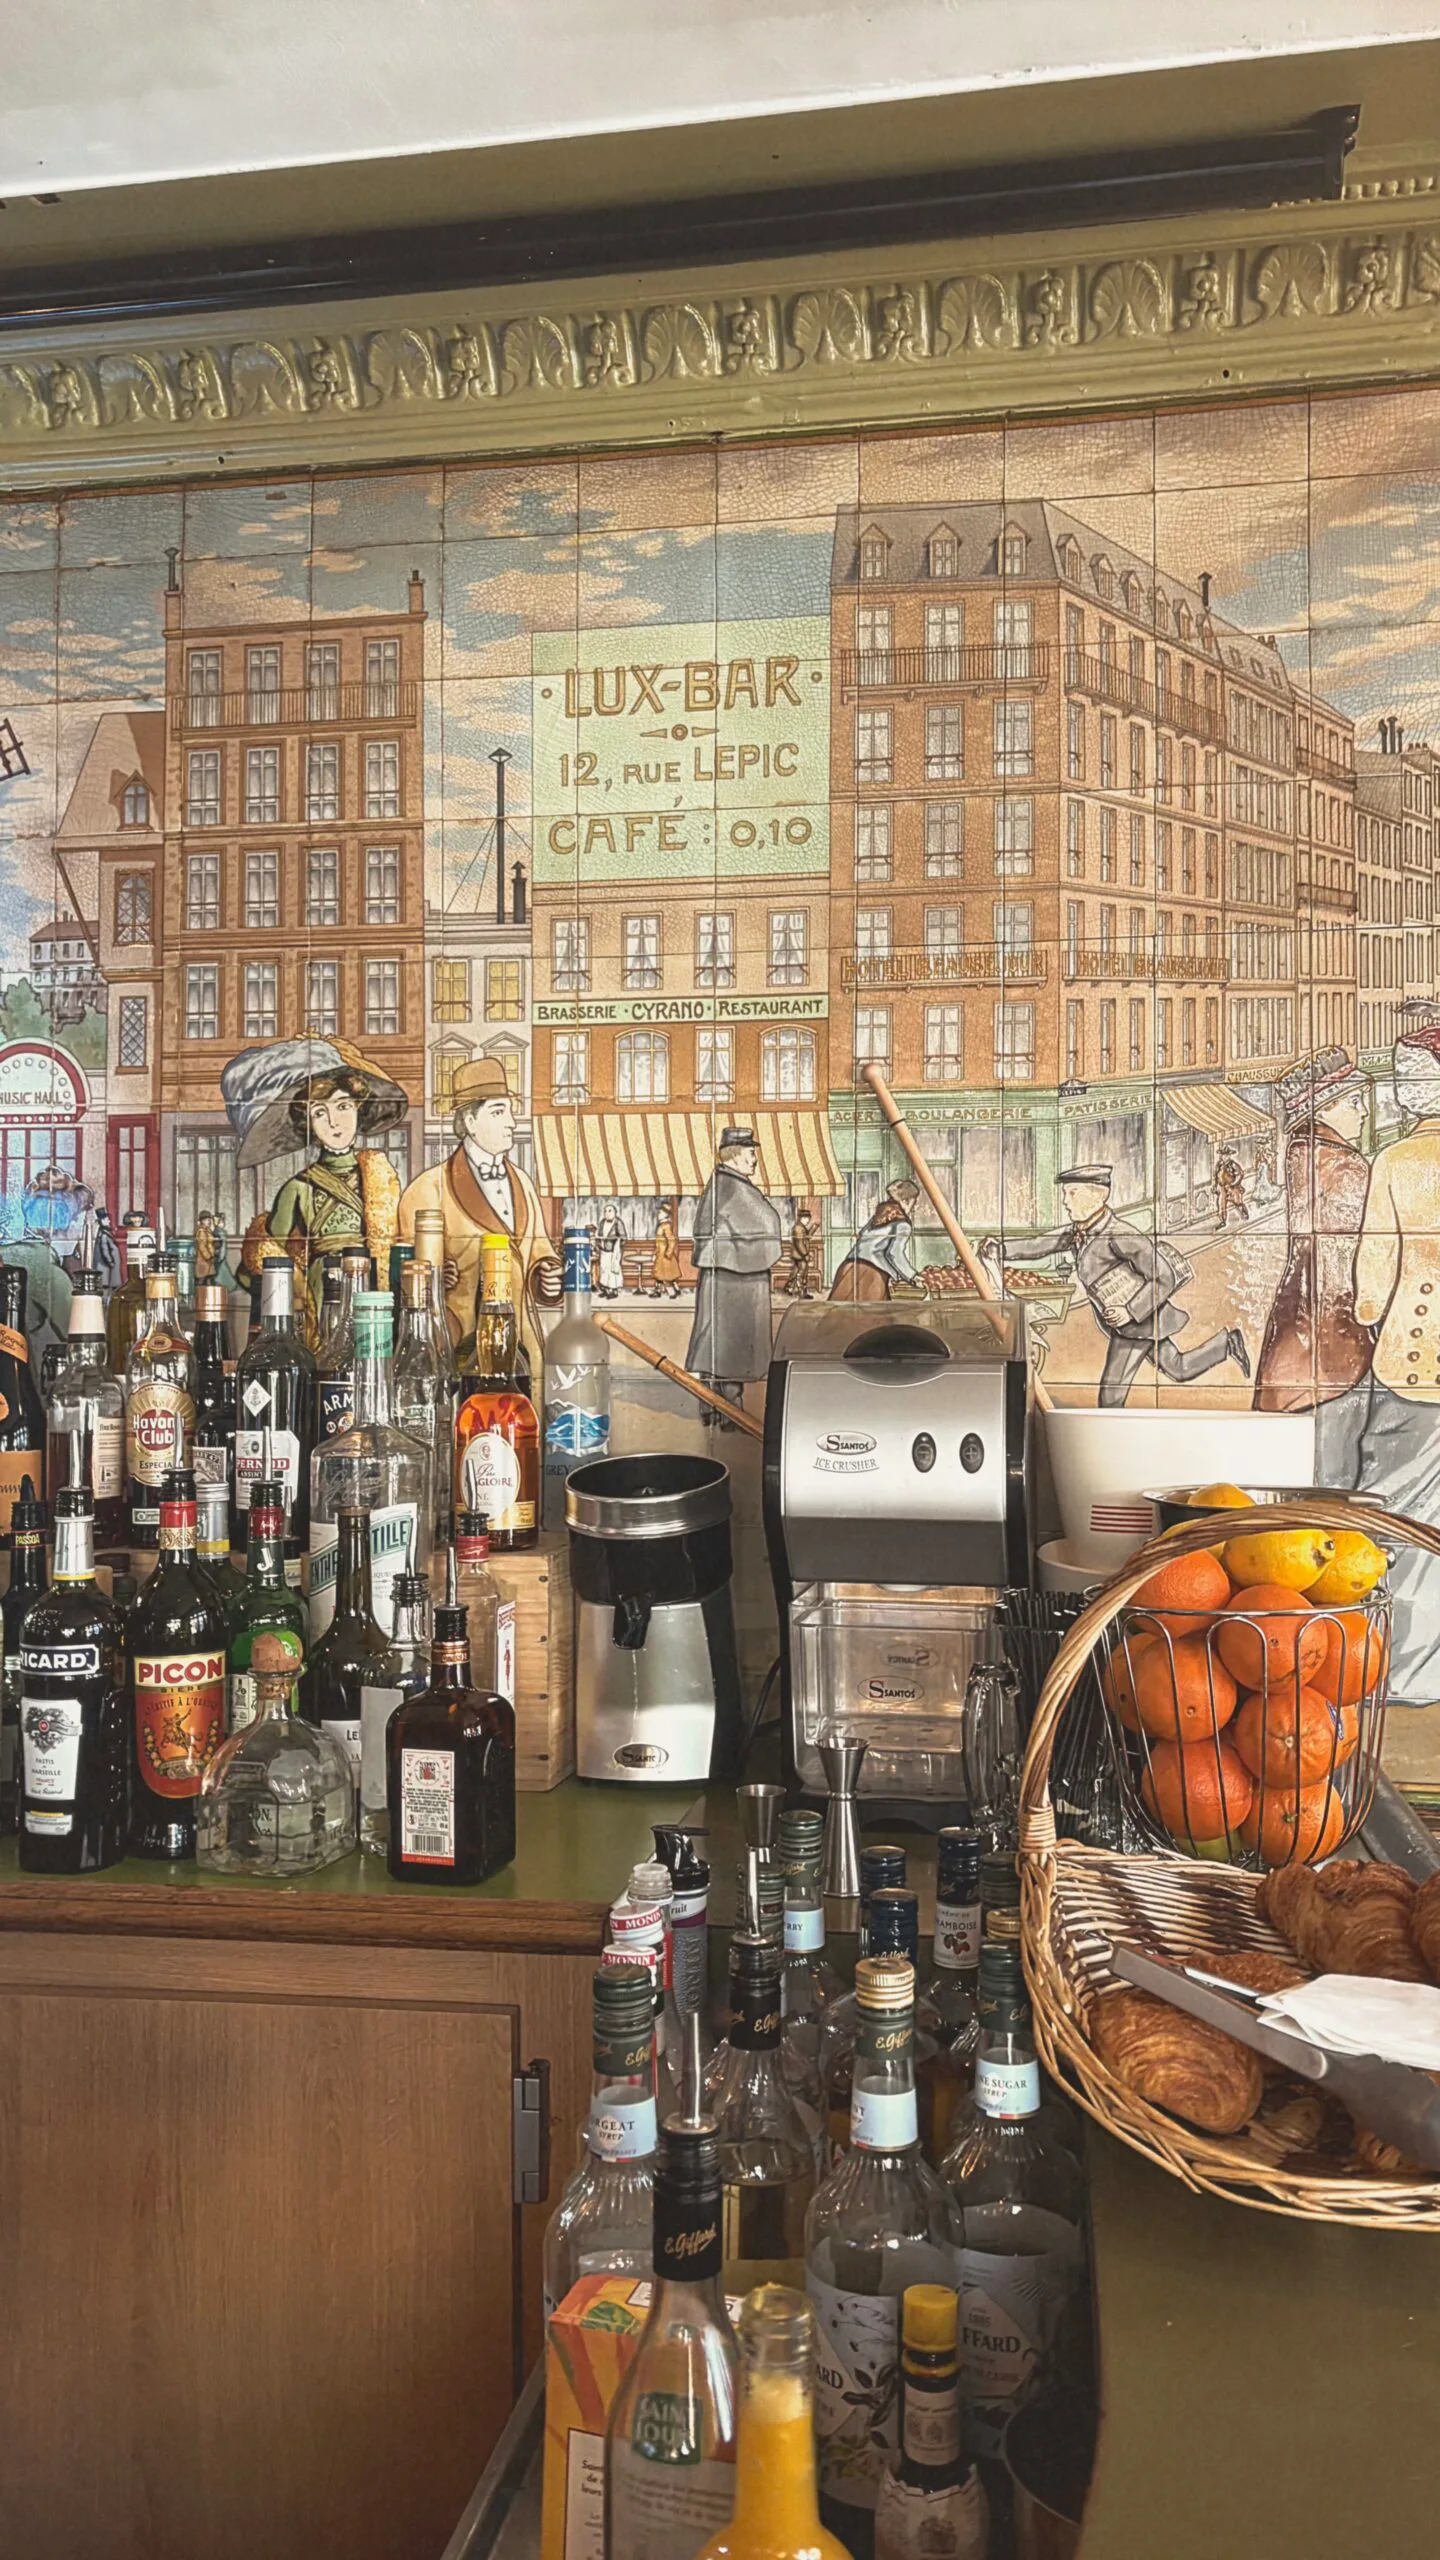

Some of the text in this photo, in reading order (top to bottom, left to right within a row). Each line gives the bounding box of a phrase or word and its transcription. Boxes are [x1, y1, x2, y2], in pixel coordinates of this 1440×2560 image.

[564, 655, 802, 719] LUX-BAR
[558, 743, 800, 792] 12, RUE LEPIC
[547, 794, 688, 855] CAFÉ
[845, 957, 909, 980] HOTEL
[537, 998, 824, 1022] BRASSERIE CYRANO RESTAURANT
[34, 1091, 63, 1105] HALL
[1064, 1094, 1152, 1116] PATISSERIE
[828, 1107, 1033, 1122] ACIER BOULANGERIE
[133, 1413, 184, 1430] Havan
[141, 1429, 174, 1445] Club
[236, 1457, 287, 1470] PERND
[815, 1456, 877, 1471] ICE CRUSHER
[138, 1655, 223, 1685] PICON
[625, 1909, 663, 1929] MONIN
[991, 2078, 1028, 2090] SUGAR
